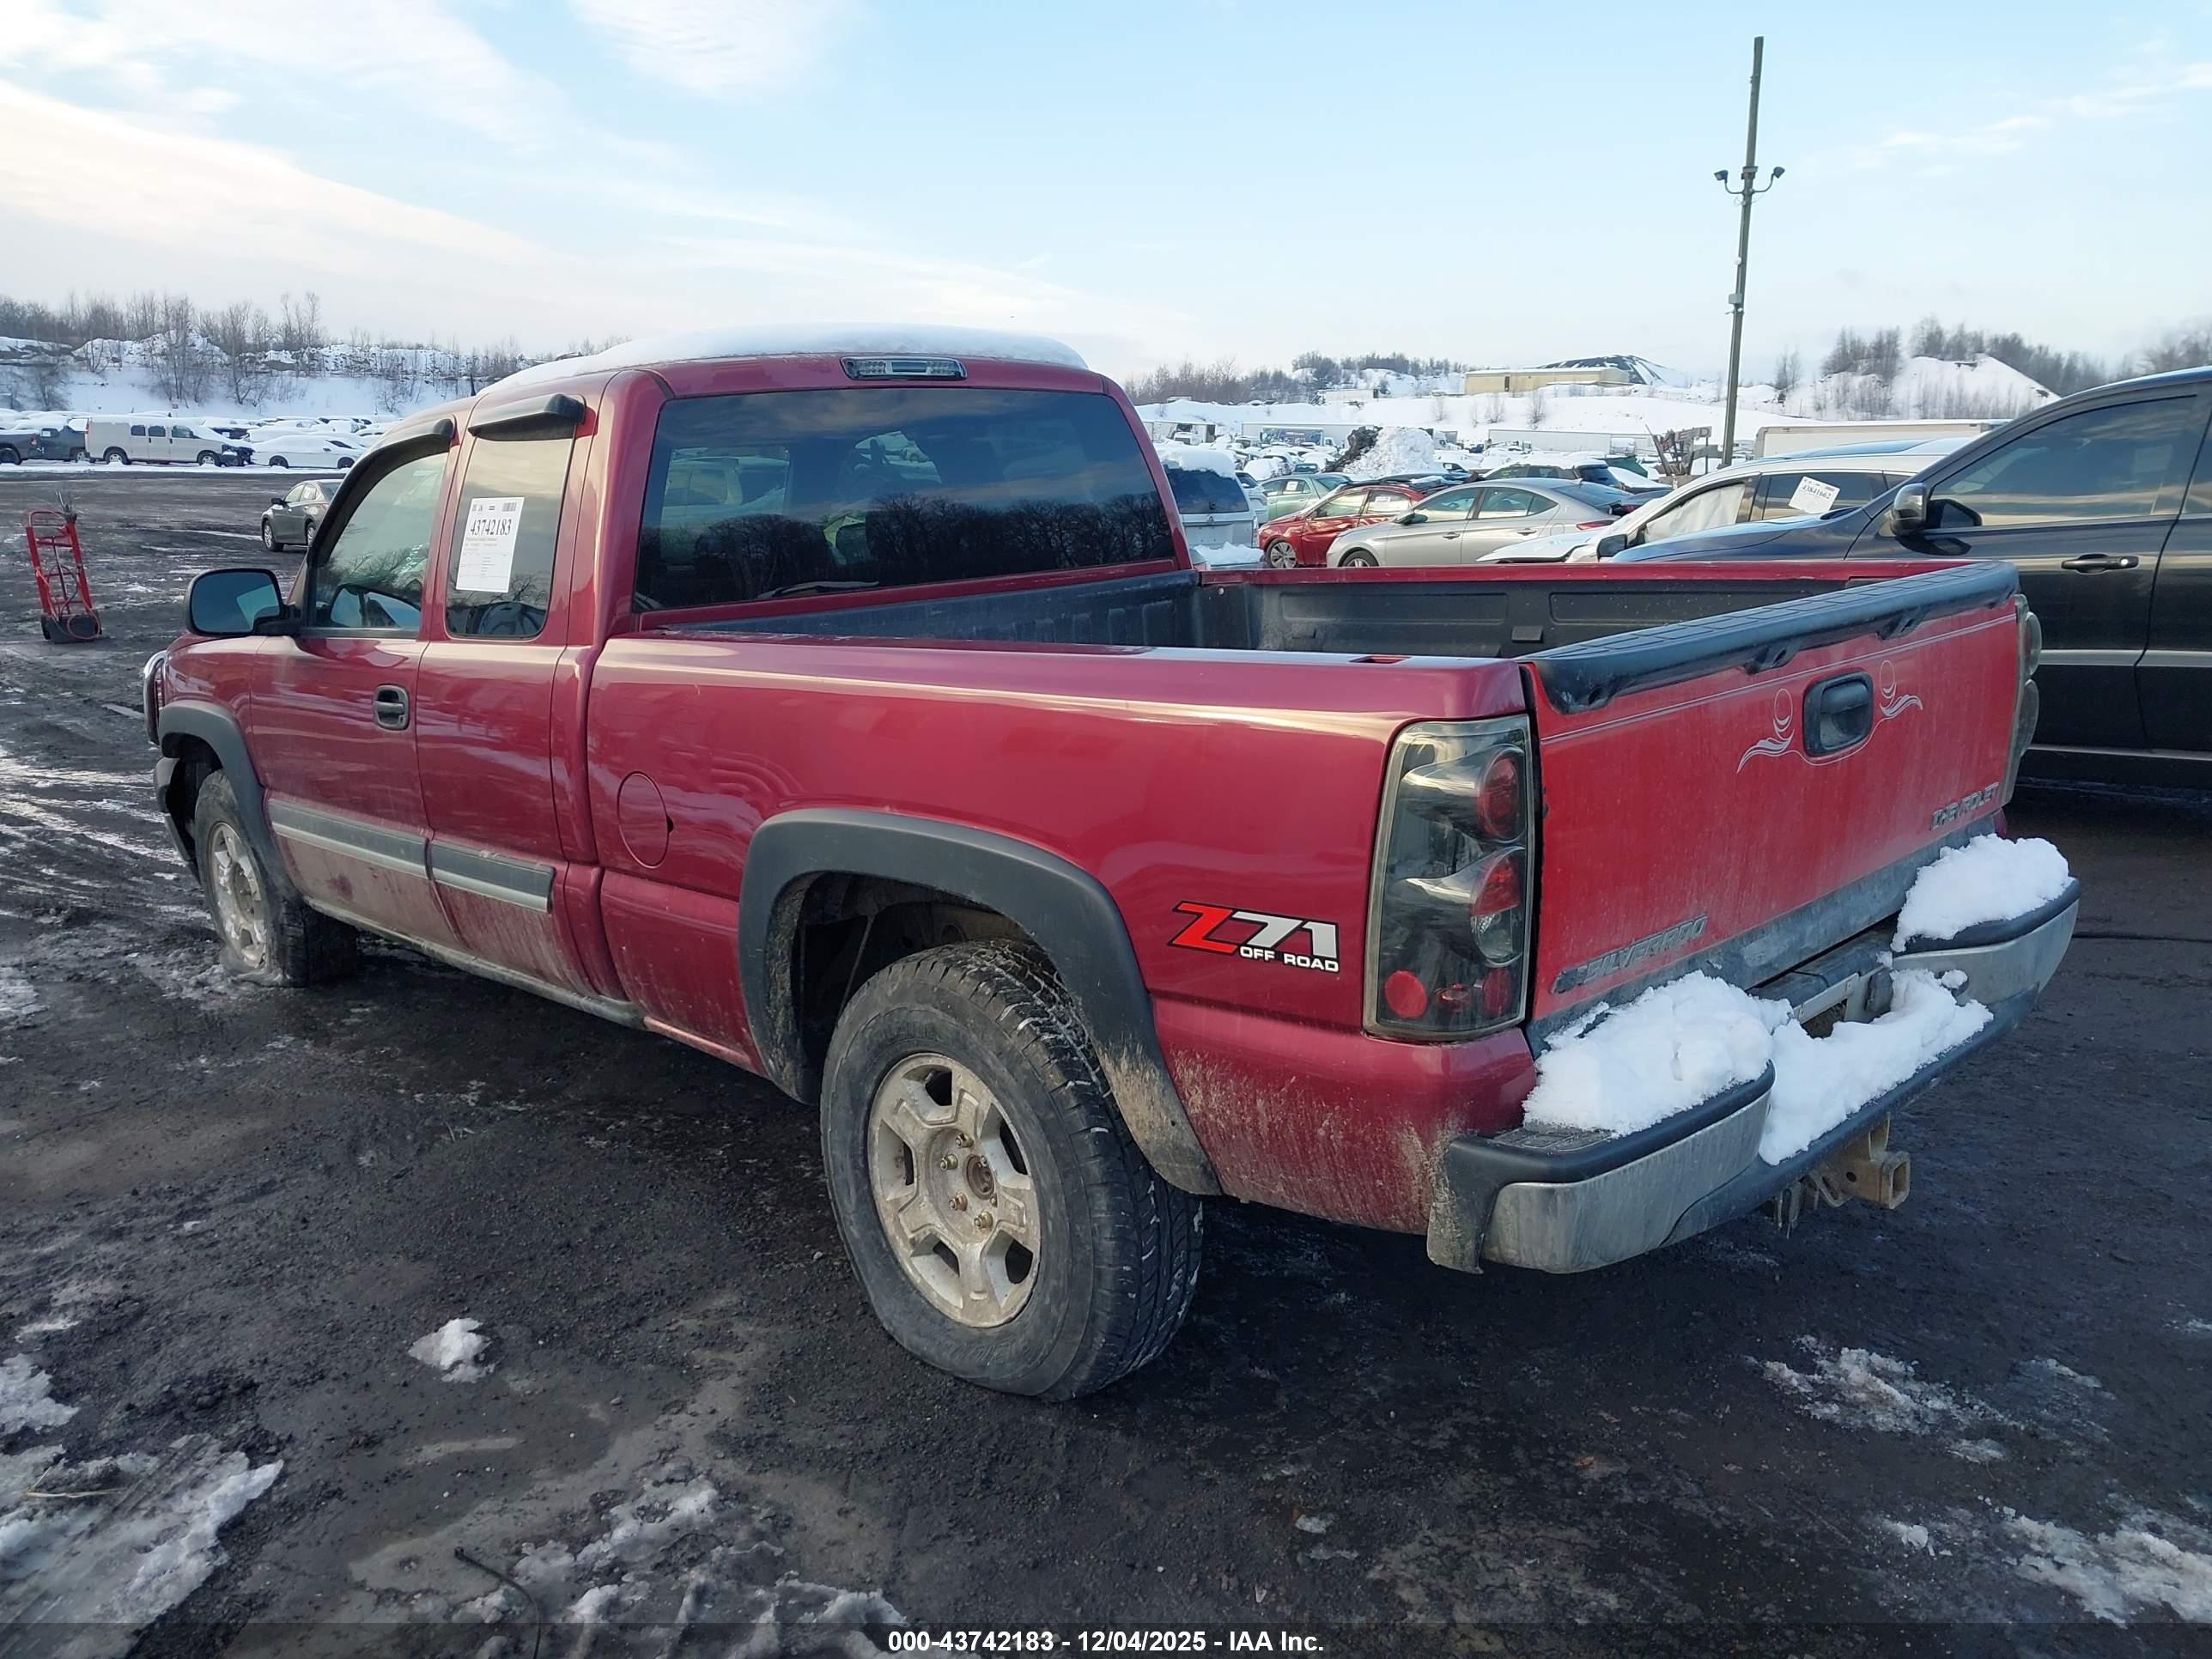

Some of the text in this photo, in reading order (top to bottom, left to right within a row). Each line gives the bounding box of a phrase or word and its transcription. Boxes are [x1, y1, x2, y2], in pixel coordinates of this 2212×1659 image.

[470, 518, 513, 536] 43742183
[1170, 902, 1338, 959] Z71
[1584, 915, 1708, 984] SILVERADO
[1239, 946, 1340, 973] OFF ROAD
